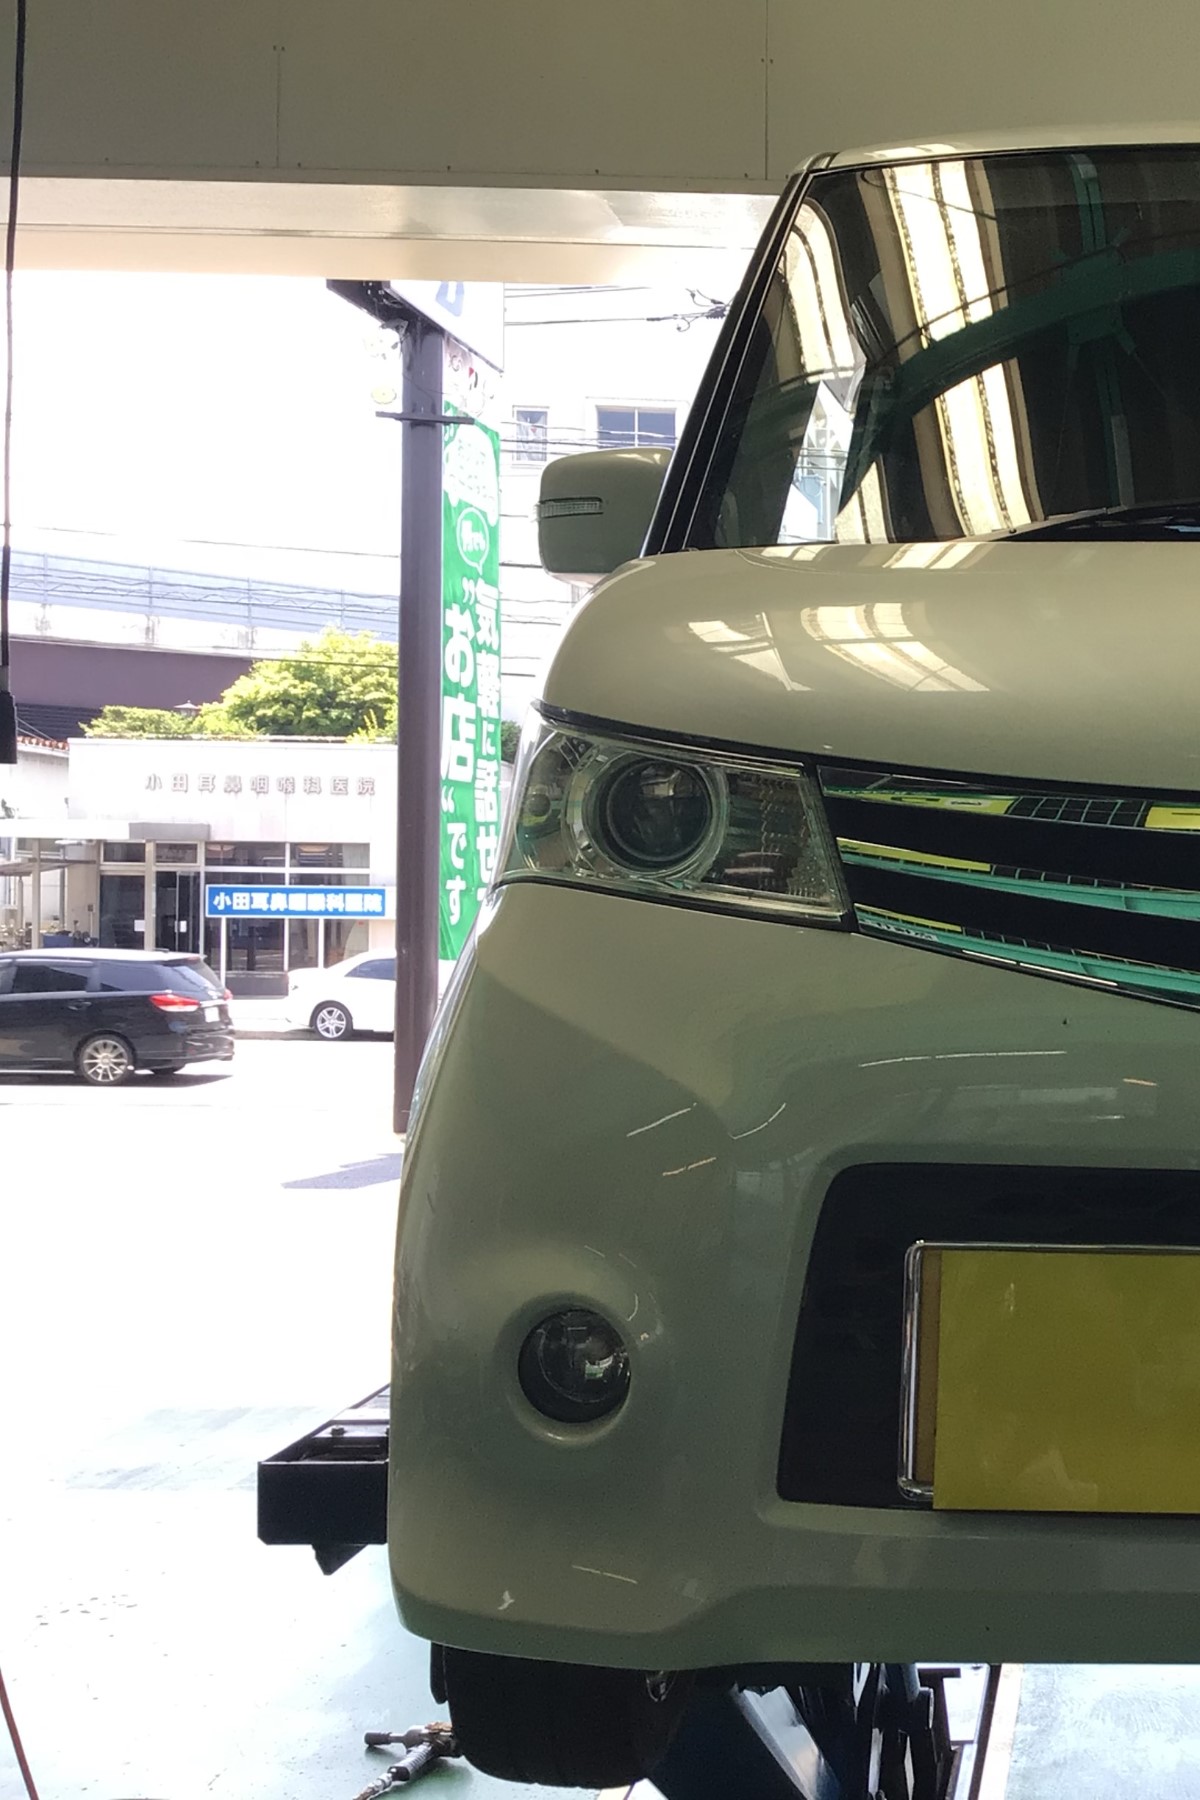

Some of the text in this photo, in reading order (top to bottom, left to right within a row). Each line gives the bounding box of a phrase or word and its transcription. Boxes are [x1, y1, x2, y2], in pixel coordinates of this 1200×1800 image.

[145, 773, 376, 796] 小田耳鼻咽喉科医院
[473, 578, 500, 906] 気軽に話せ
